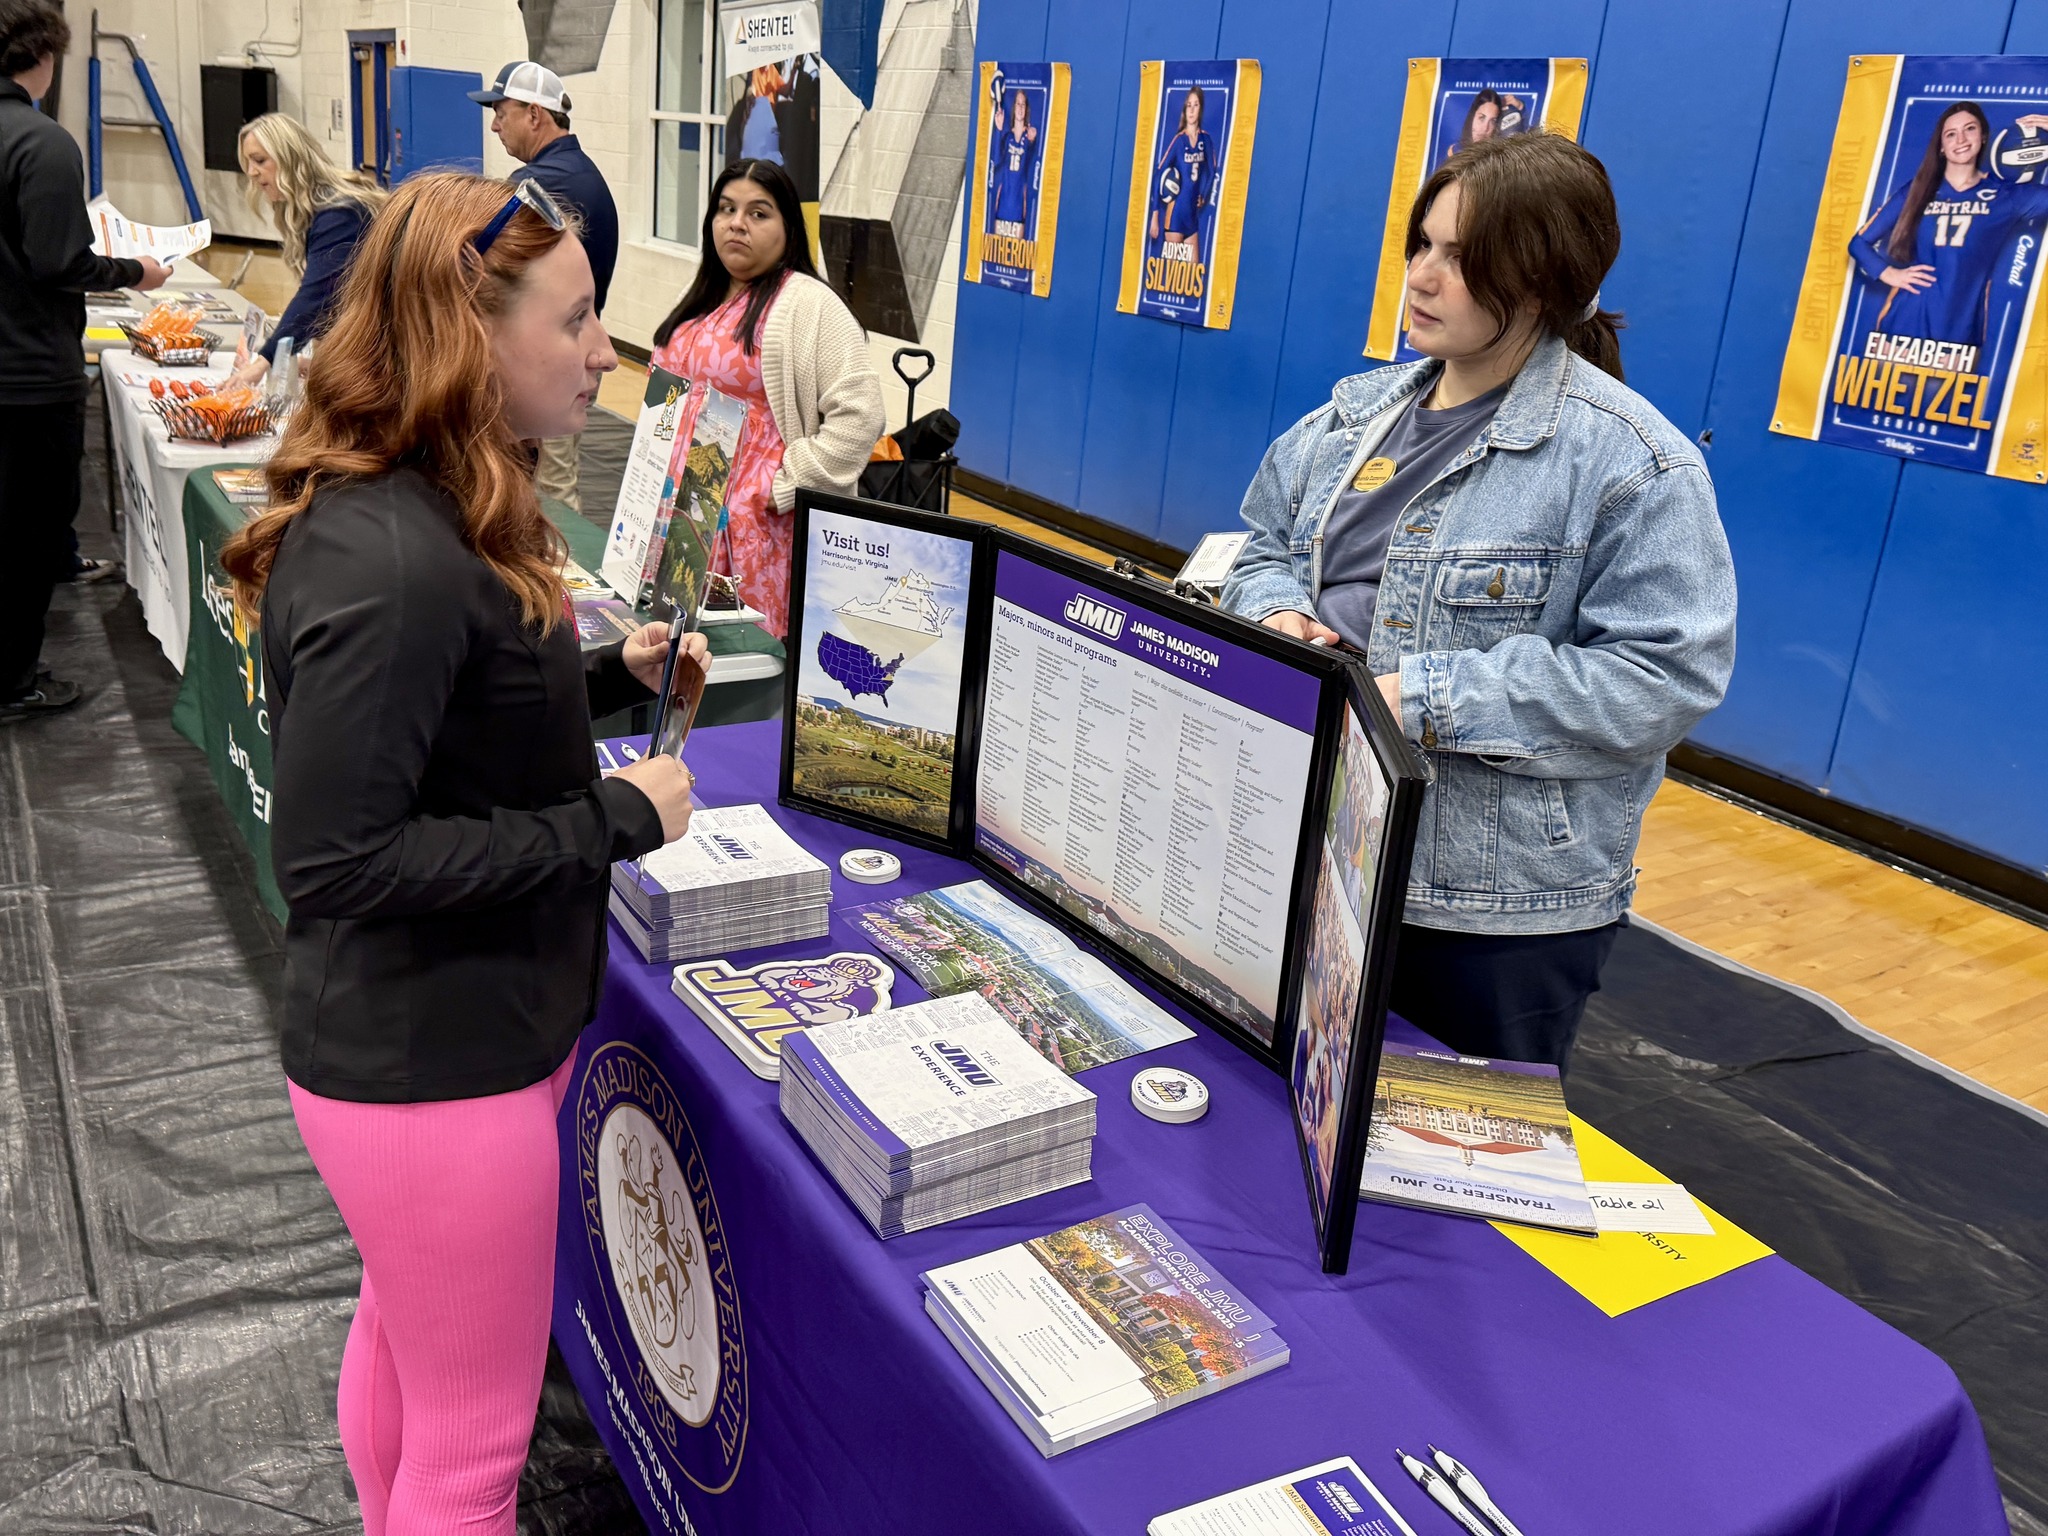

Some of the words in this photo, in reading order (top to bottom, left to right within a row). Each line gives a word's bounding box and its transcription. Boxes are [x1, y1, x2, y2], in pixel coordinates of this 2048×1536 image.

[748, 15, 794, 39] SHENTEL
[1924, 85, 1970, 93] CENTRAL
[1191, 162, 1199, 182] 5
[1924, 201, 1990, 215] CENTRAL
[996, 220, 1020, 237] HADLEY
[1803, 258, 1837, 343] CENTRAL
[1821, 137, 1866, 255] VOLLEYBALL
[1935, 215, 1973, 247] 17
[981, 233, 1037, 270] WITHEROW
[1161, 241, 1194, 262] ADYSEN
[2009, 235, 2034, 288] Central
[1145, 256, 1206, 298] SILVIOUS
[1158, 294, 1185, 305] SENIOR
[1864, 331, 1977, 373] ELIZABETH
[1833, 354, 1992, 430] WHETZEL
[1872, 414, 1938, 435] SENIOR
[822, 529, 860, 552] Visit
[865, 543, 890, 558] us!
[820, 558, 857, 572] jmu.edu/visit
[821, 550, 864, 565] Harrisonburg,
[865, 558, 889, 570] Virginia
[906, 585, 934, 596] Harrisonburg
[1065, 598, 1123, 638] JMU
[999, 605, 1026, 627] Majors,
[1027, 619, 1055, 639] minors
[1056, 634, 1073, 648] and
[1074, 642, 1118, 668] programs
[1130, 620, 1165, 645] JAMES
[1167, 635, 1220, 668] MADISON
[693, 835, 727, 865] EXPERIENCE
[712, 835, 753, 859] JMU
[859, 920, 880, 936] NEW
[908, 944, 922, 952] TO
[920, 951, 942, 968] YOUR
[934, 1042, 997, 1085] JMU
[980, 1050, 1001, 1067] THE
[1458, 1057, 1490, 1066] JMU
[911, 1045, 967, 1097] EXPERIENCE
[1147, 1080, 1178, 1102] JMU
[840, 1092, 863, 1116] ADMISSIONS
[1390, 1175, 1428, 1188] JMU
[1432, 1182, 1458, 1194] TO
[1433, 1176, 1453, 1185] Path
[1454, 1179, 1473, 1188] Your
[1474, 1182, 1508, 1194] Discover
[1462, 1188, 1556, 1211] TRANSFER
[1588, 1195, 1637, 1210] Table
[1642, 1199, 1665, 1211] 21
[581, 1097, 605, 1250] JAMES
[593, 1056, 684, 1150] MADISON
[687, 1147, 745, 1466] UNIVERSITY
[1127, 1213, 1211, 1286] EXPLORE
[1203, 1288, 1253, 1323] JMU
[997, 1269, 1009, 1282] Learn
[1008, 1281, 1017, 1291] more
[1118, 1219, 1161, 1258] ACADEMIC
[1157, 1256, 1181, 1280] OPEN
[1178, 1277, 1215, 1312] HOUSES
[1211, 1309, 1236, 1330] 2025
[943, 1278, 964, 1296] JMU
[1034, 1290, 1050, 1308] Madison
[1049, 1306, 1069, 1328] Experience
[1039, 1275, 1062, 1299] October
[1071, 1309, 1101, 1343] November
[1047, 1324, 1059, 1337] Other
[1057, 1336, 1070, 1350] things
[575, 1299, 612, 1383] JAMES
[612, 1374, 672, 1501] MADISON
[637, 1361, 677, 1448] 1908
[1285, 1487, 1302, 1505] JMU
[1298, 1502, 1322, 1529] Student
[1316, 1480, 1334, 1503] JAMES
[1331, 1498, 1355, 1523] MADISON
[1331, 1484, 1361, 1512] JMU
